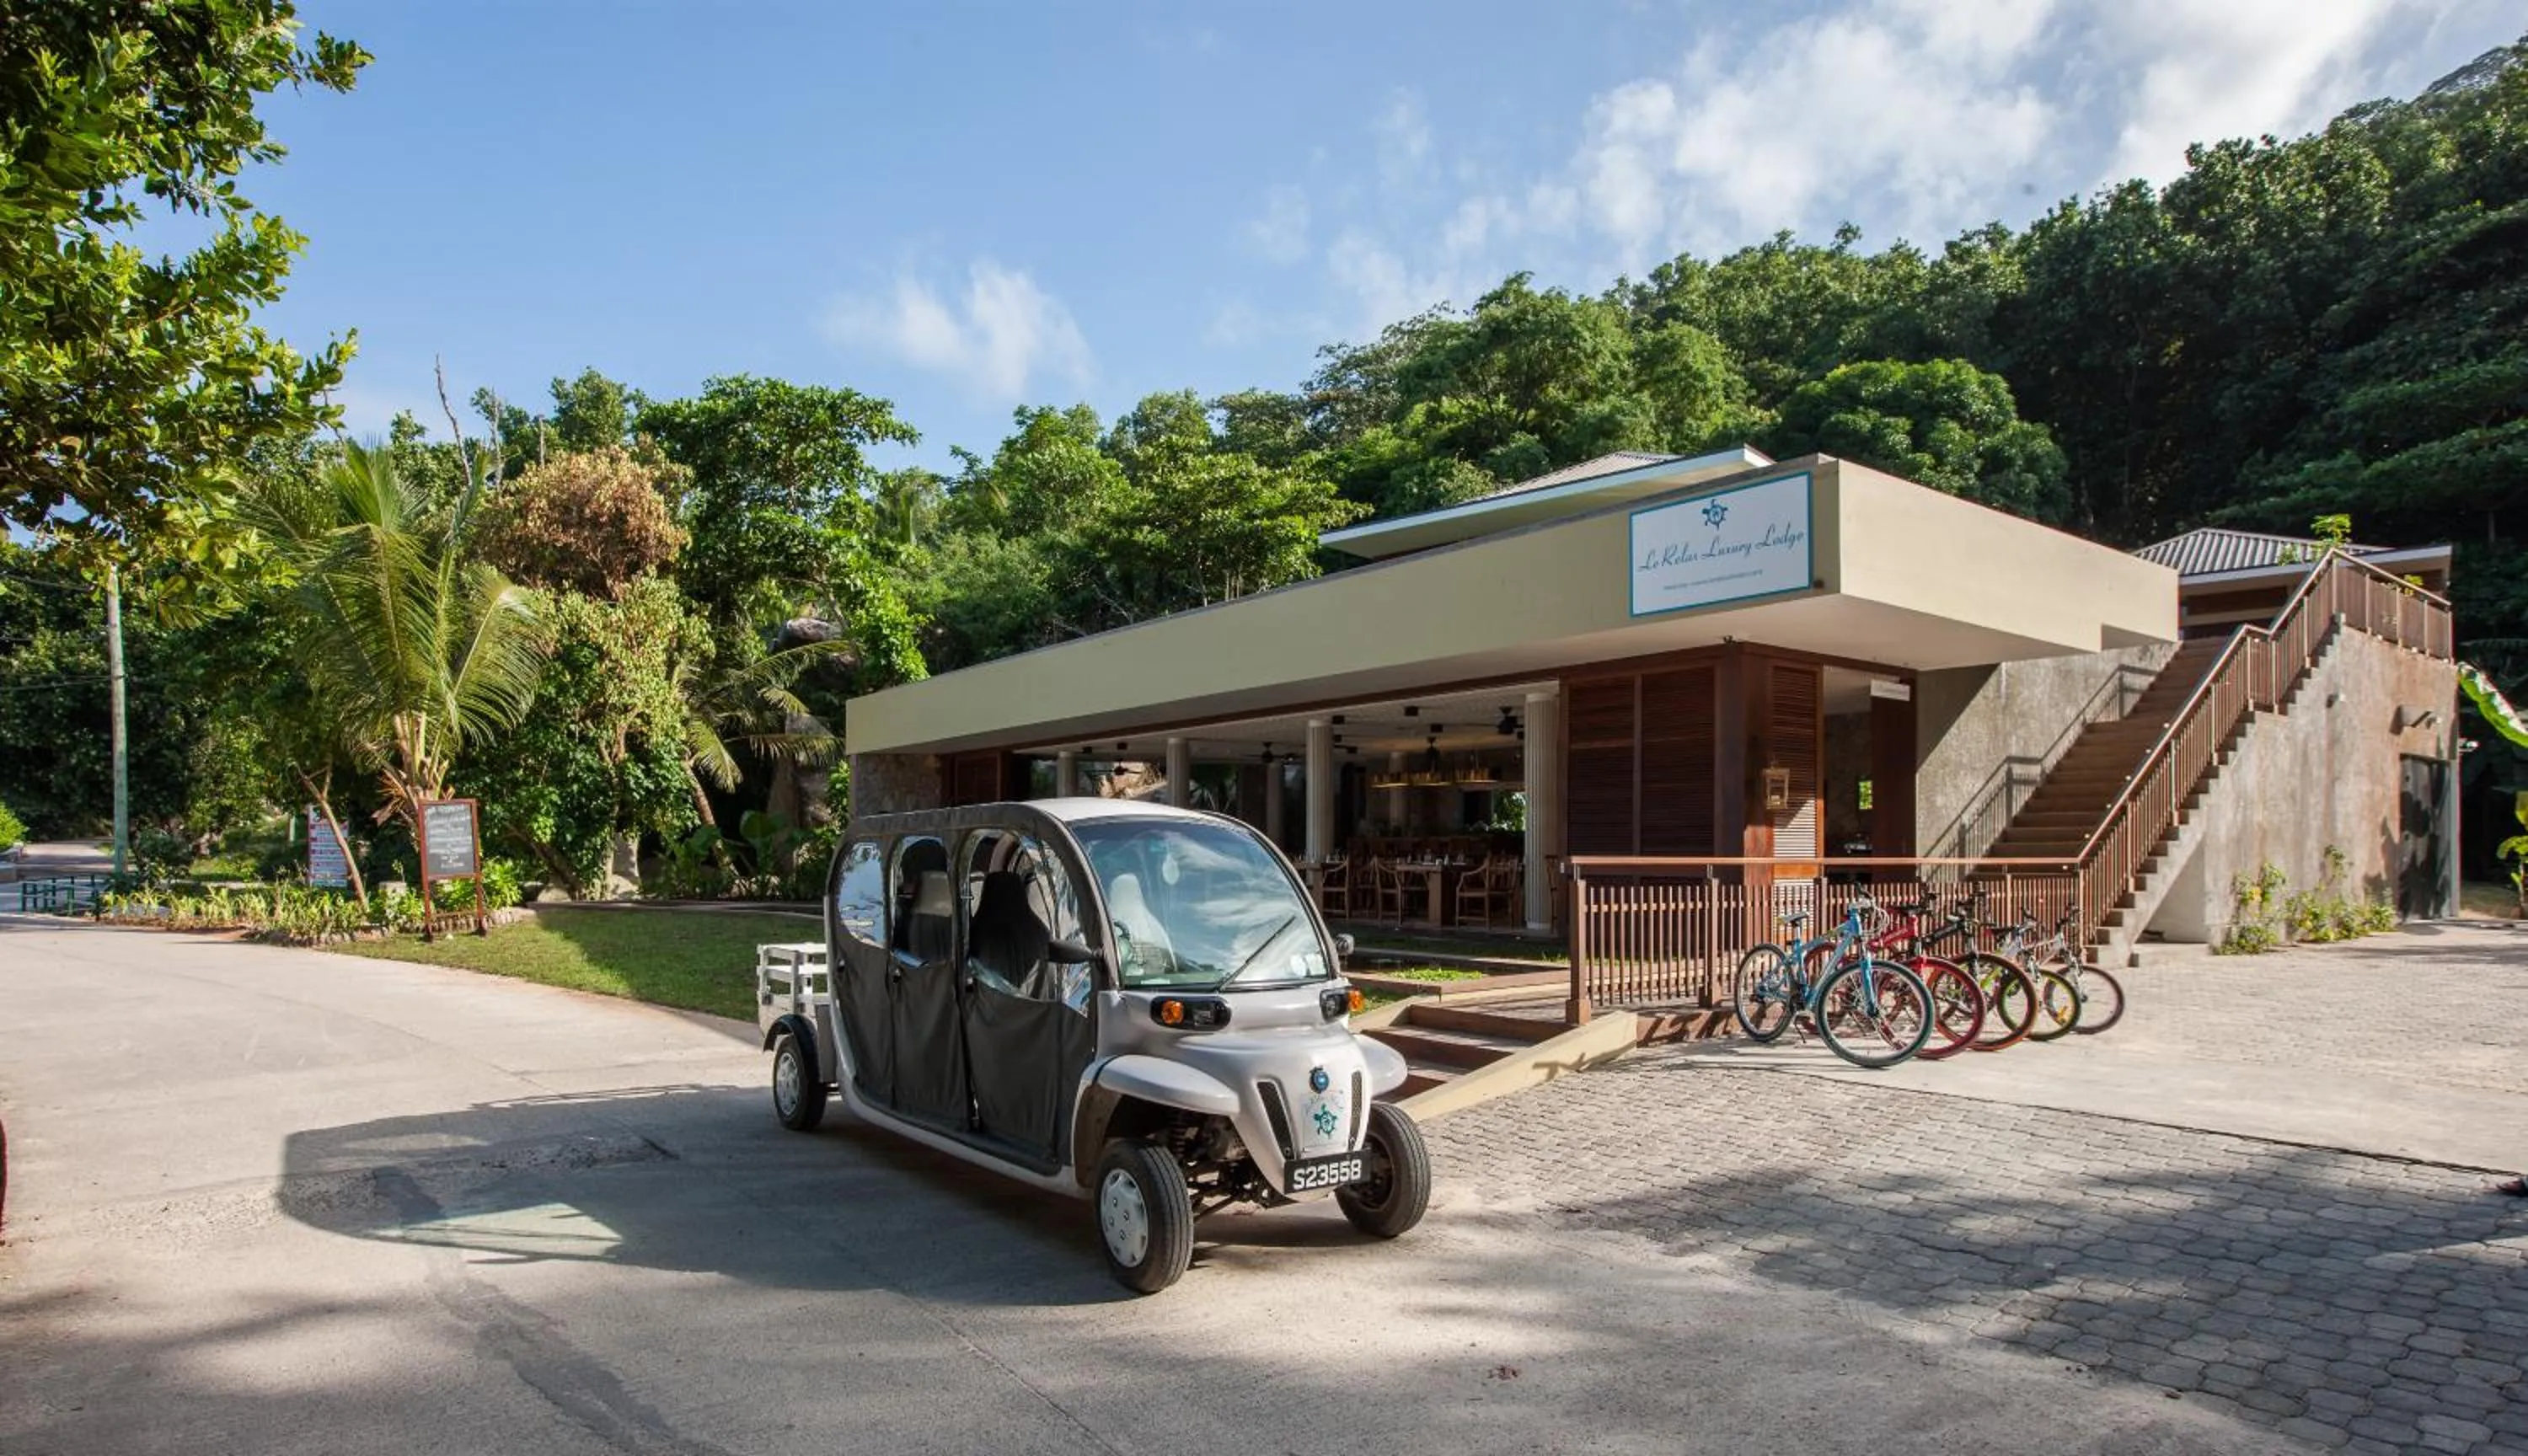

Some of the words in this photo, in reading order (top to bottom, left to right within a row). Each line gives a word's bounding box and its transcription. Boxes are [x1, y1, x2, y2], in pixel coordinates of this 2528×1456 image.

[1637, 549, 1659, 573] Le
[1701, 535, 1752, 559] Luxury
[1754, 522, 1804, 549] Lodge
[1292, 1159, 1362, 1190] S23558
